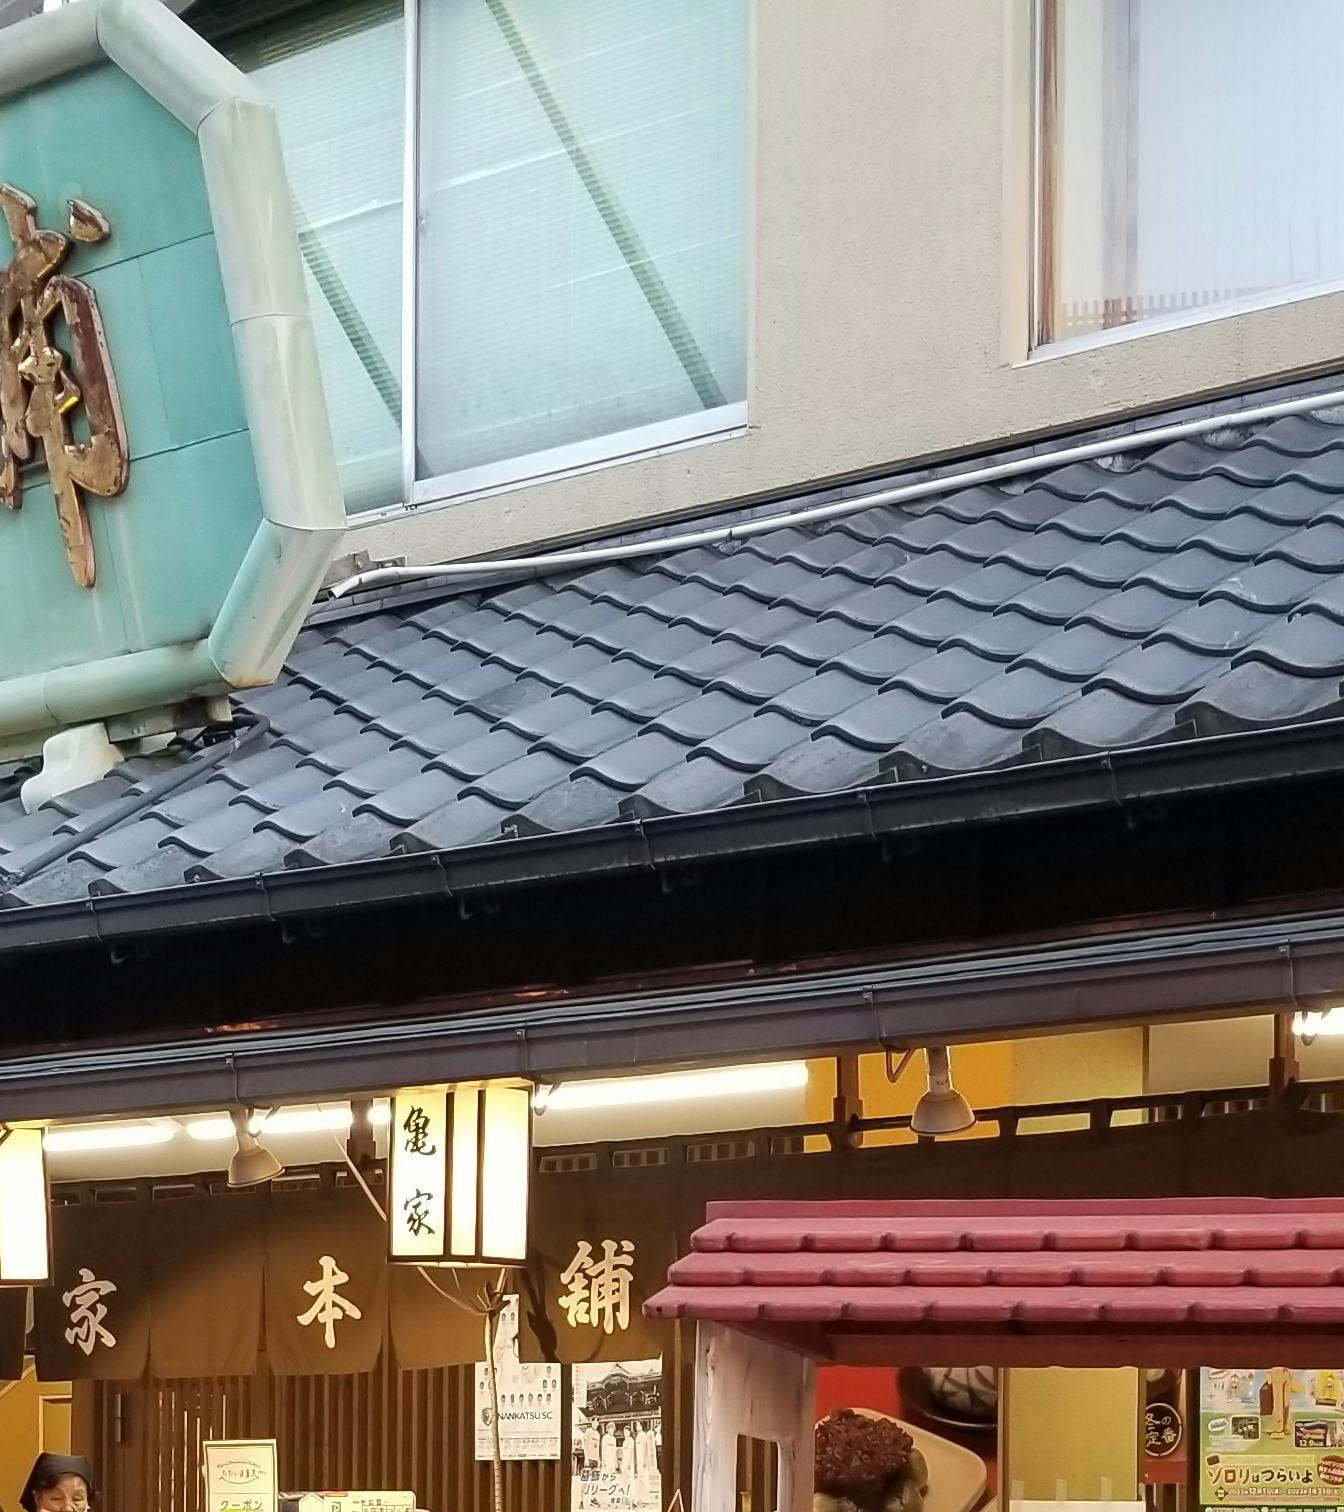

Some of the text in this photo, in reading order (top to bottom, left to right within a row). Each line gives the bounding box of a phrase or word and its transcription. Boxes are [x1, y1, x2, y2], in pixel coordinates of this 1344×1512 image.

[403, 1105, 437, 1237] 亀家
[497, 1411, 553, 1420] NANKATSU SC
[220, 1499, 263, 1512] クーポン
